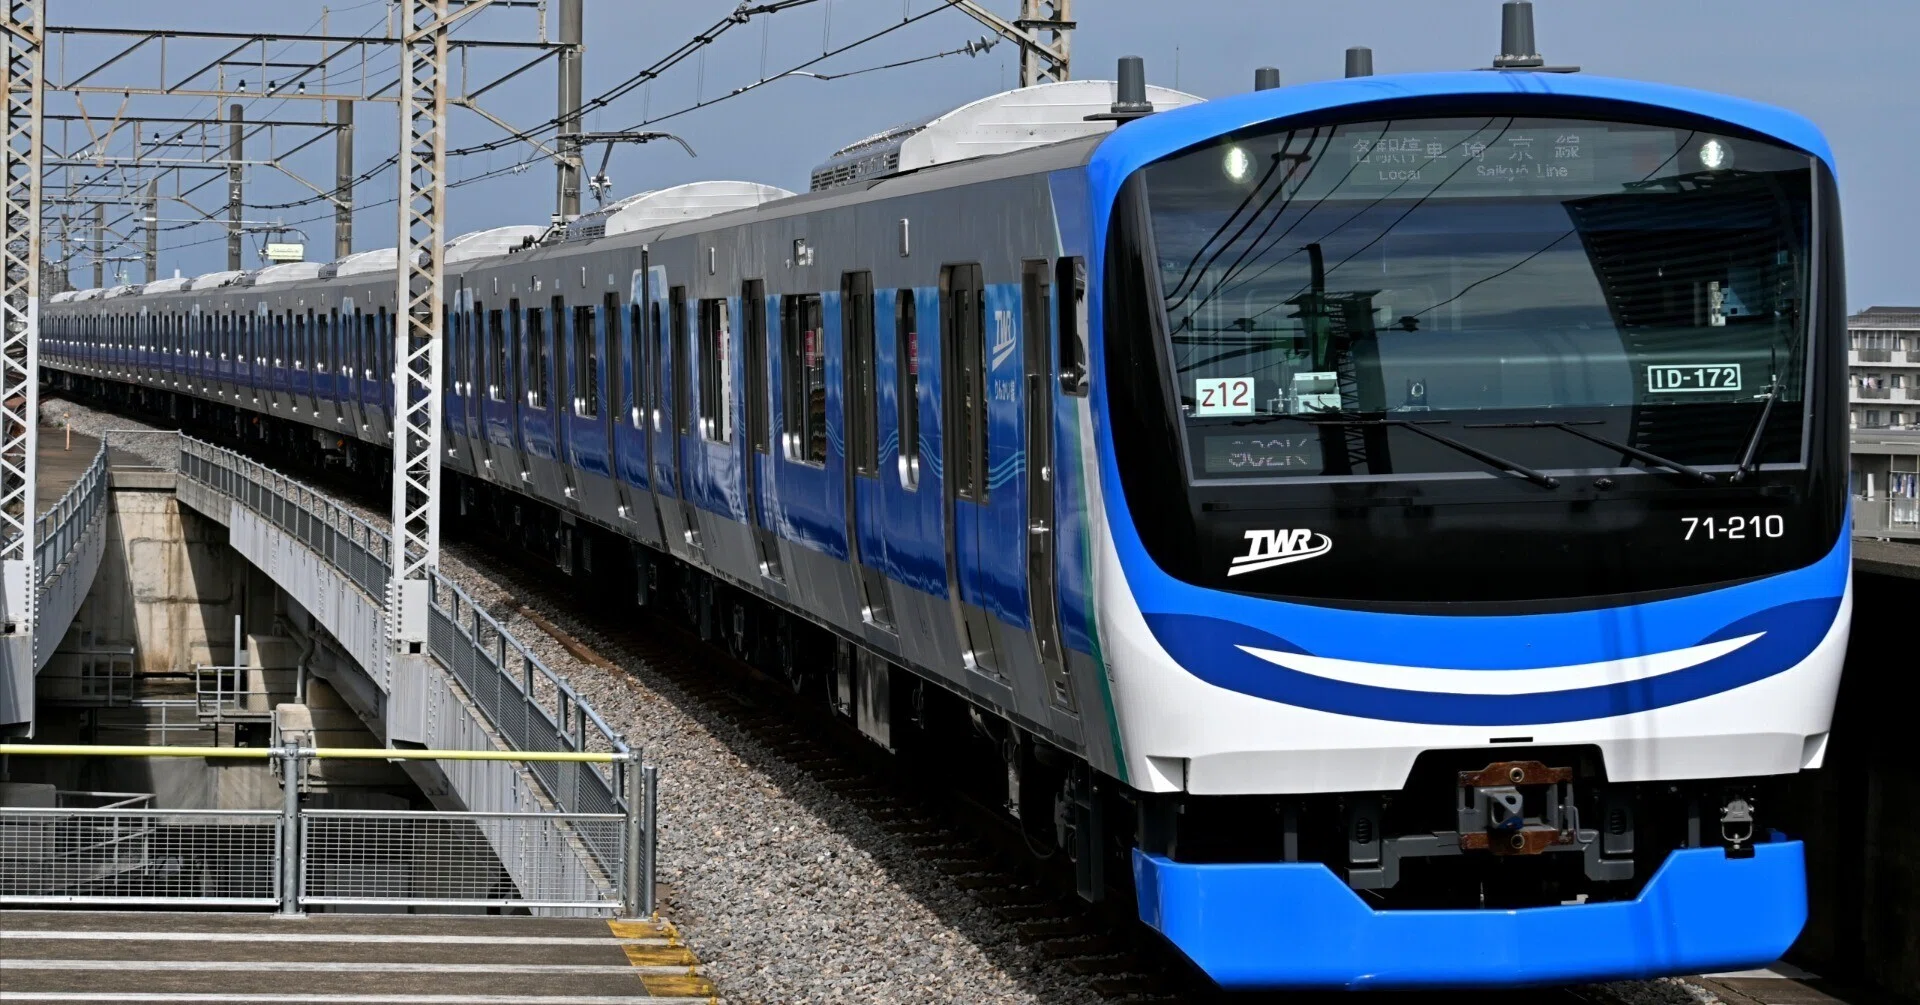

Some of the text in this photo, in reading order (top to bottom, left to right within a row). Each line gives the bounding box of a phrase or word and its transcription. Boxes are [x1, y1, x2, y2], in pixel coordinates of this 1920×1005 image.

[1379, 169, 1421, 181] Local
[1537, 164, 1568, 178] Line
[1656, 368, 1737, 388] ID-172
[1202, 381, 1249, 407] z12
[1681, 515, 1784, 540] 71-210
